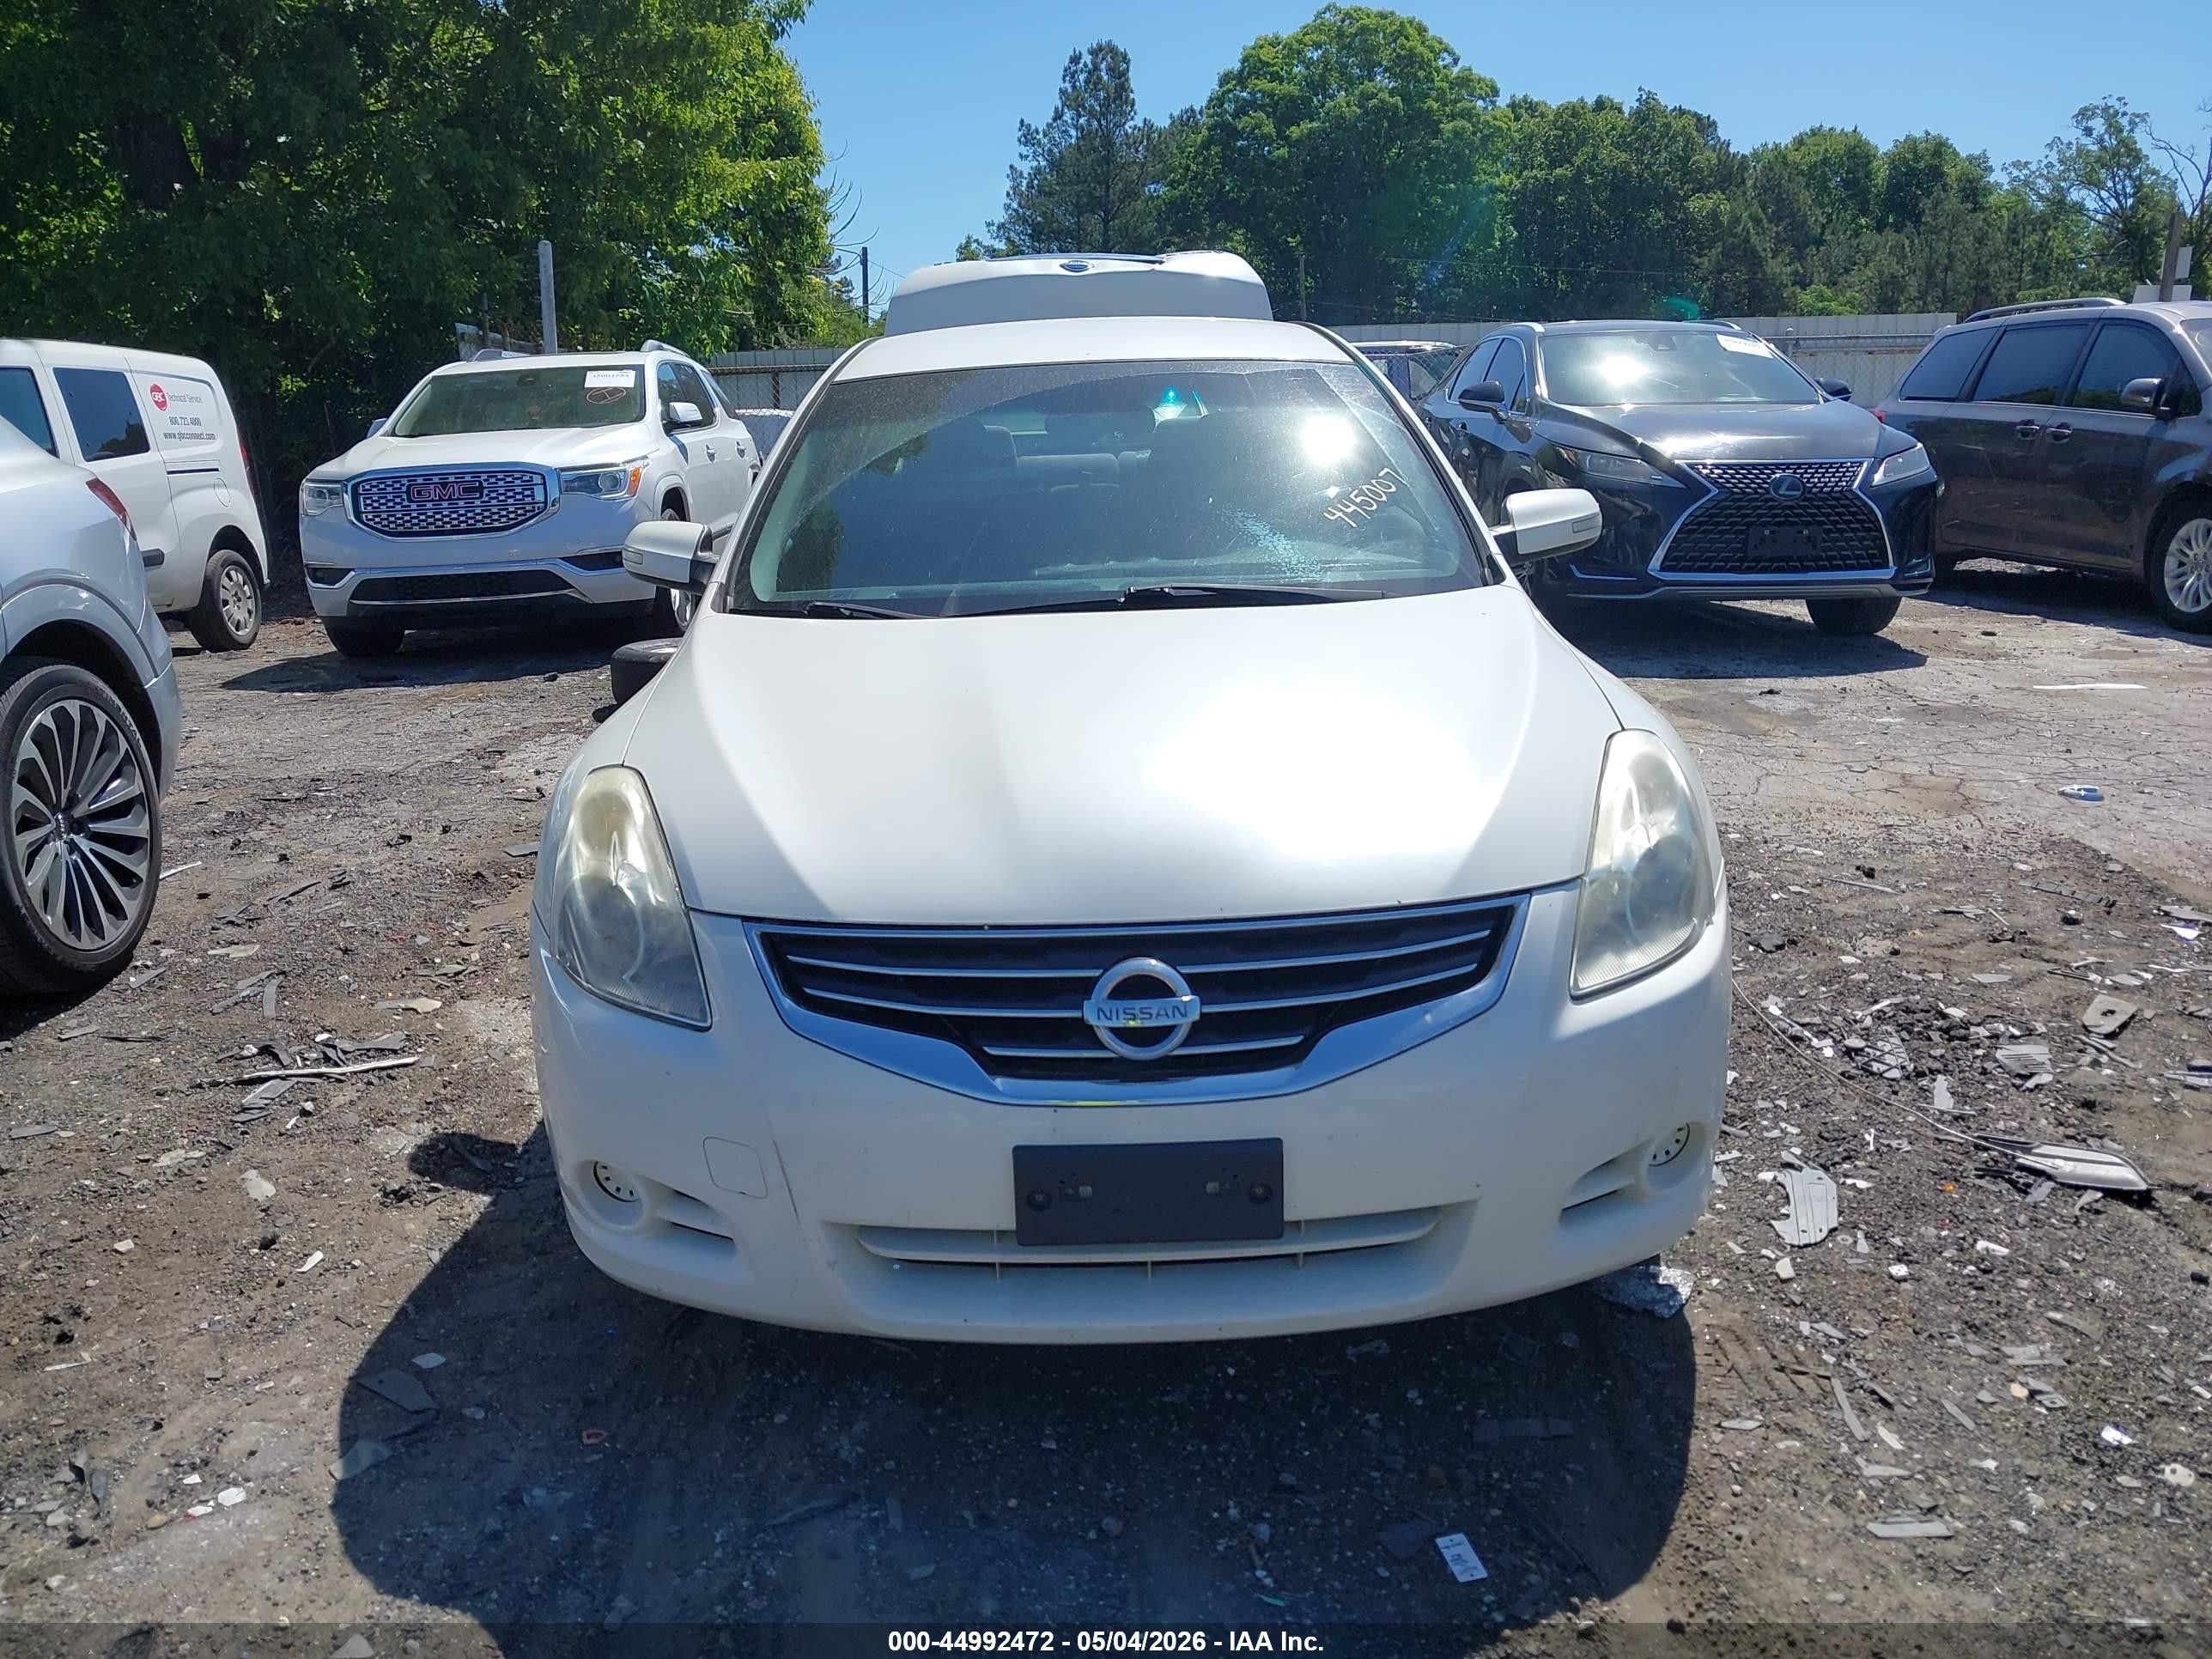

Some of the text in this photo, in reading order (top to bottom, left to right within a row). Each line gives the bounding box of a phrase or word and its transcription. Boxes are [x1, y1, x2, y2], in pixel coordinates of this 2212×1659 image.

[410, 482, 480, 501] GMC
[1323, 468, 1410, 527] 445007
[1097, 1005, 1188, 1021] NISSAN
